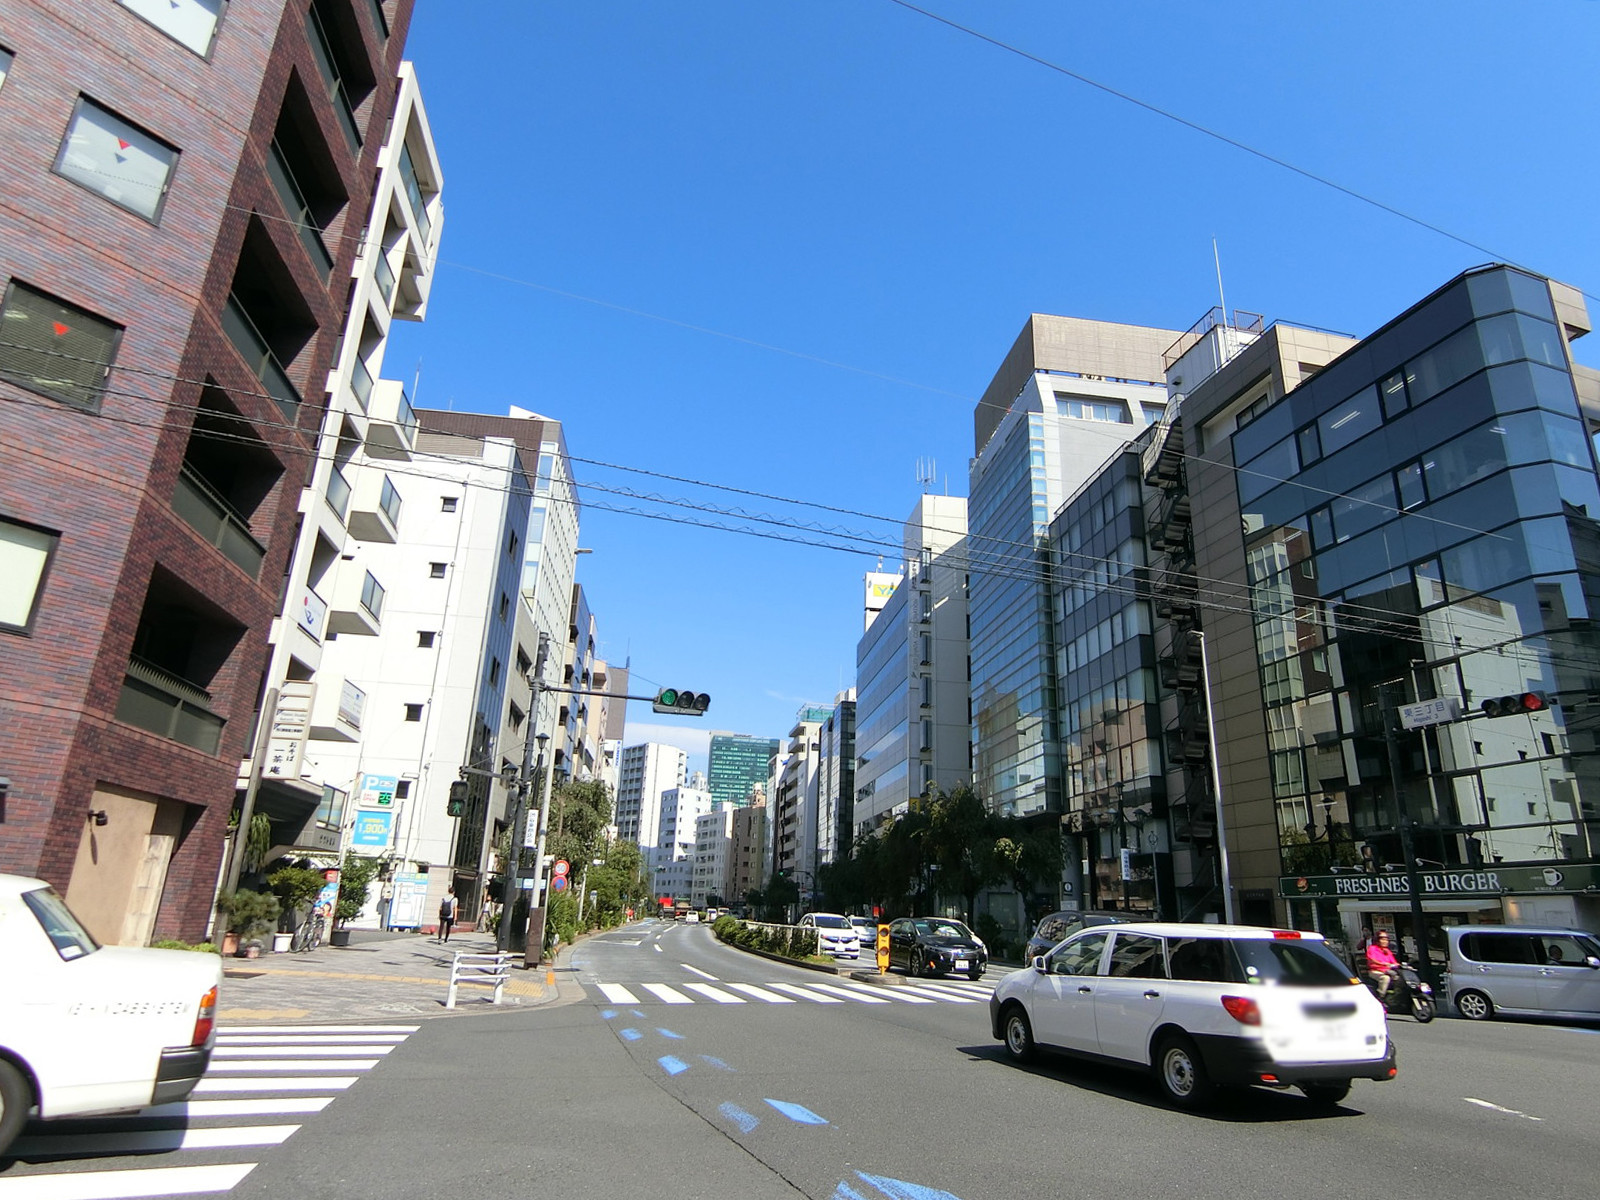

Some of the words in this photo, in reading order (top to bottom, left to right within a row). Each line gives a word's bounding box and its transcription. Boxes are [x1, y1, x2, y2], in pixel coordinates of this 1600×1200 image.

[1403, 701, 1445, 718] 東三丁目
[365, 776, 379, 790] P
[1335, 876, 1410, 894] FRESHNES
[1423, 872, 1501, 892] BURGER
